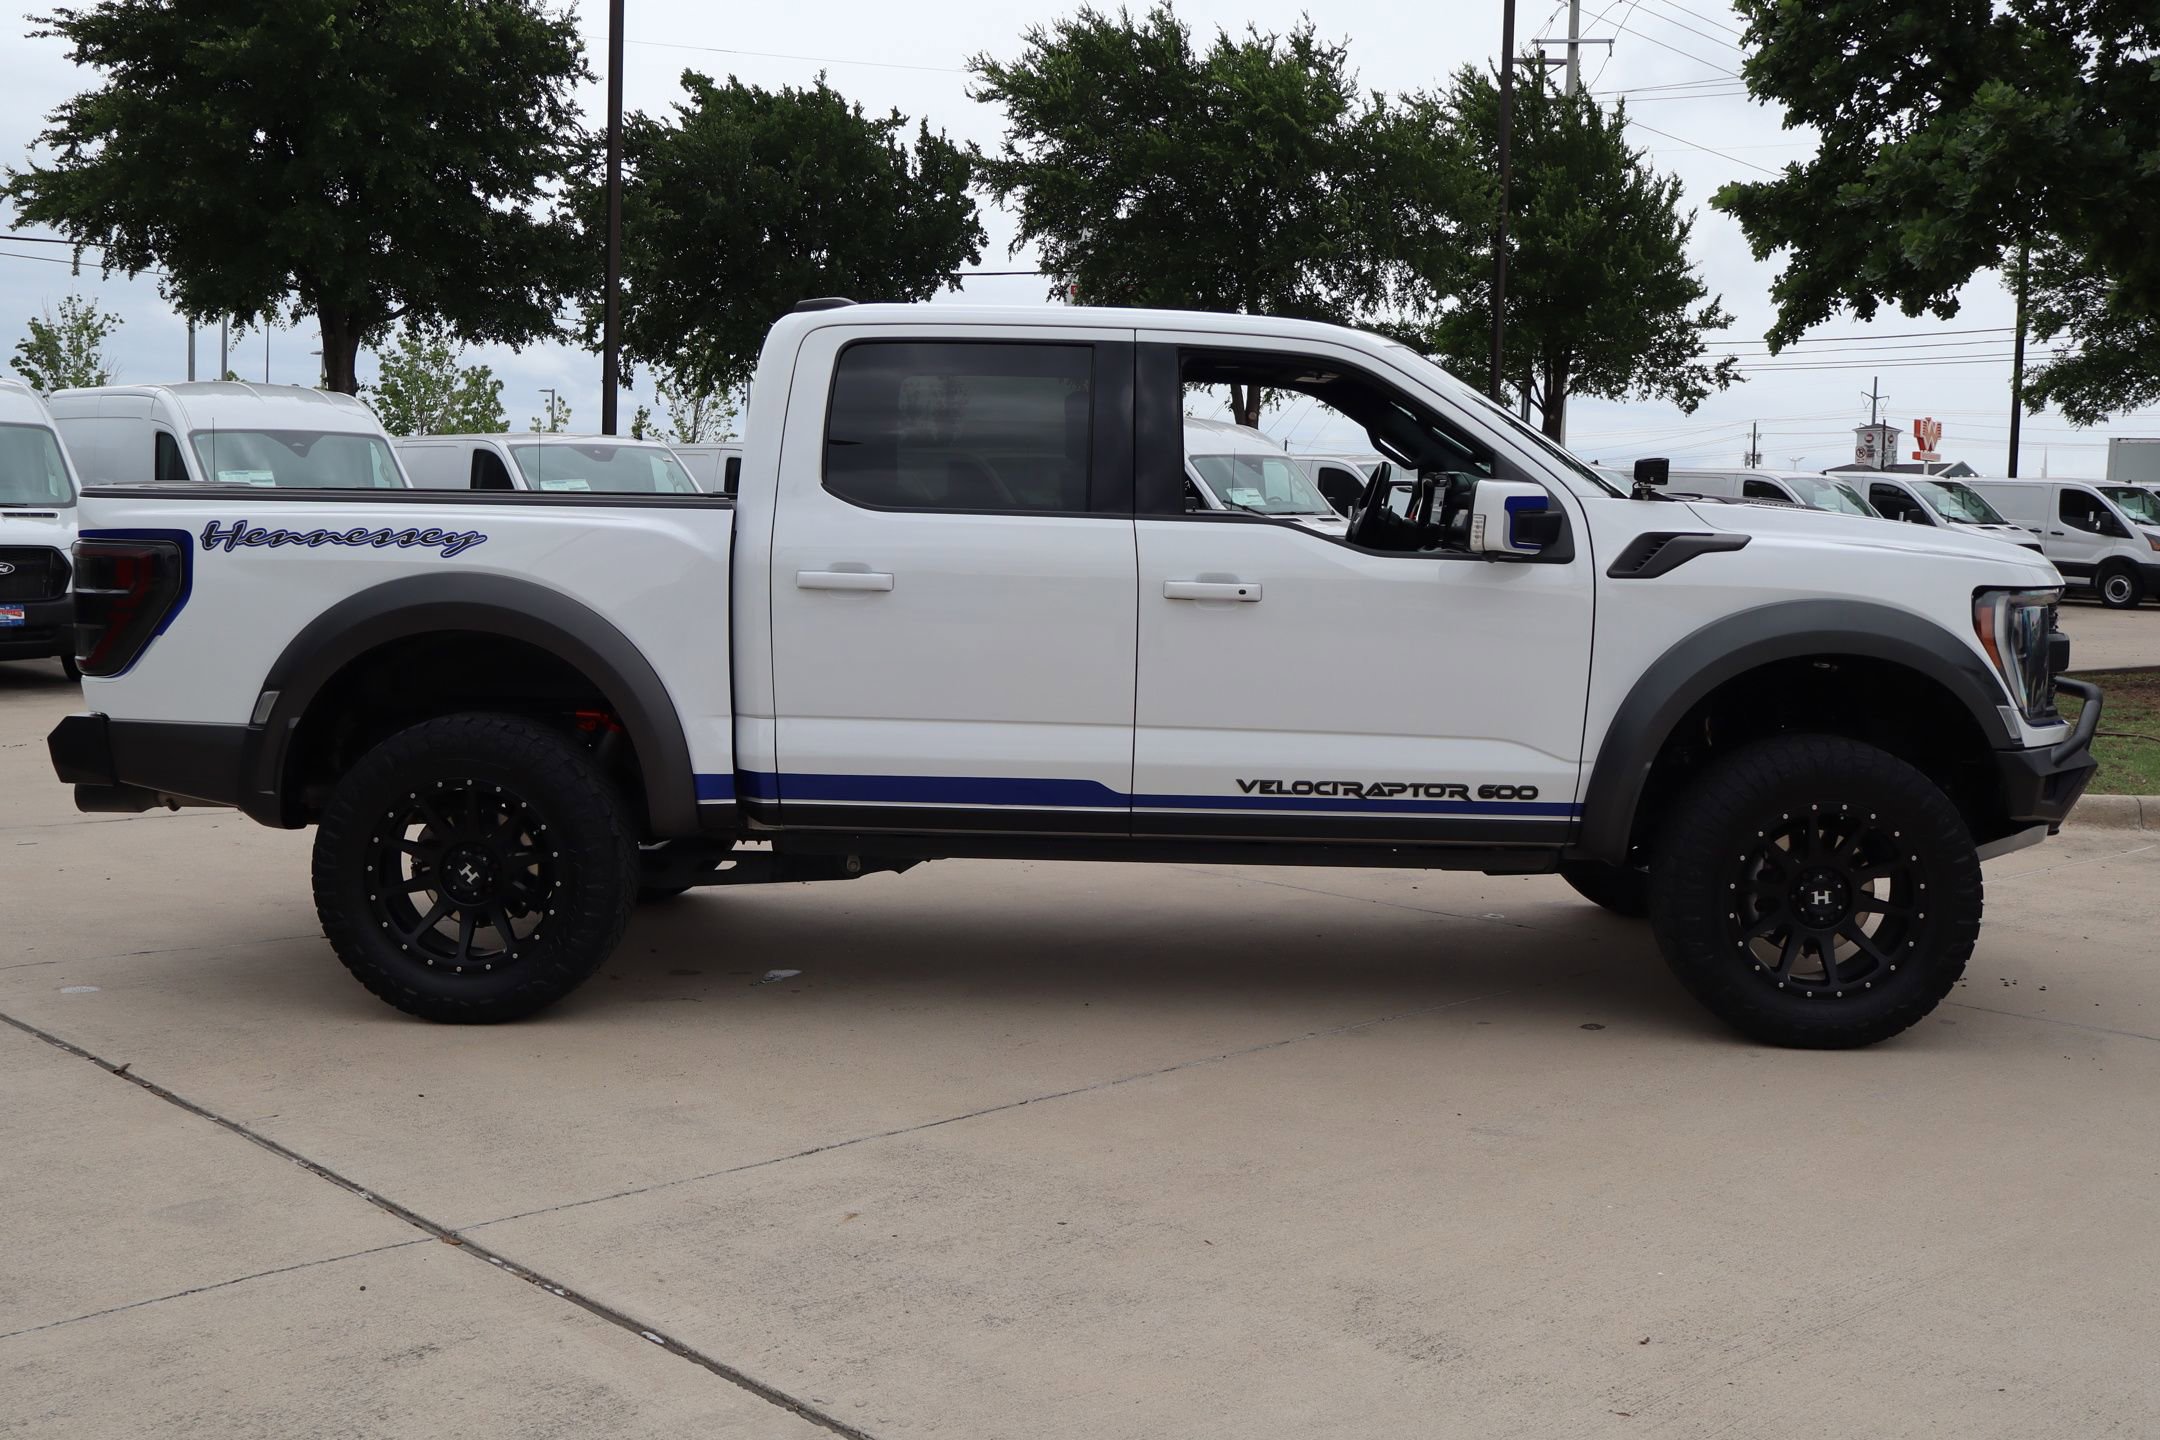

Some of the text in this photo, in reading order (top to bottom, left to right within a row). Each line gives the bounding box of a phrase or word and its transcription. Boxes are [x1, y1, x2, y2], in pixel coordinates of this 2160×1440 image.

[201, 520, 486, 557] Hennessey
[1236, 779, 1539, 802] VELOCIRAPTOR 600
[1811, 890, 1832, 904] H
